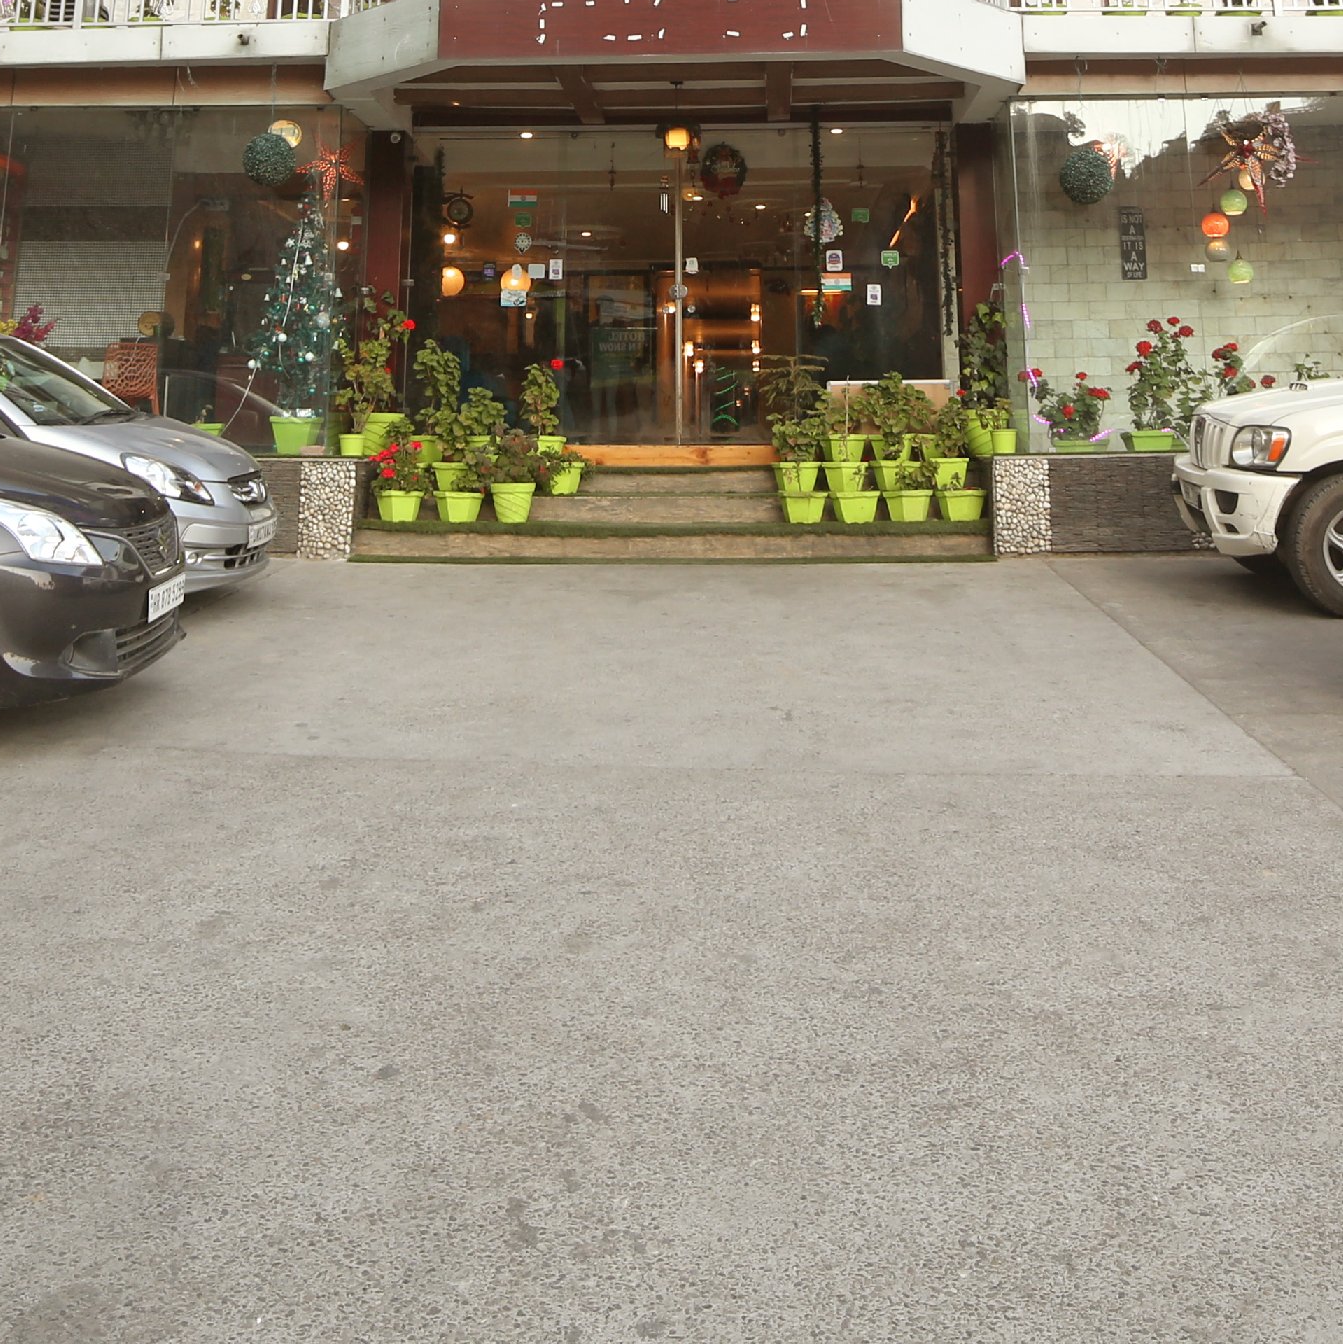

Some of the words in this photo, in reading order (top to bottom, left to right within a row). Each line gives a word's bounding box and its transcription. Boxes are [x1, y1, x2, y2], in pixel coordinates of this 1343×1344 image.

[1129, 225, 1136, 235] A
[1123, 241, 1131, 250] IT
[1135, 241, 1143, 250] IS
[1131, 251, 1138, 261] A
[1123, 262, 1144, 271] WAY
